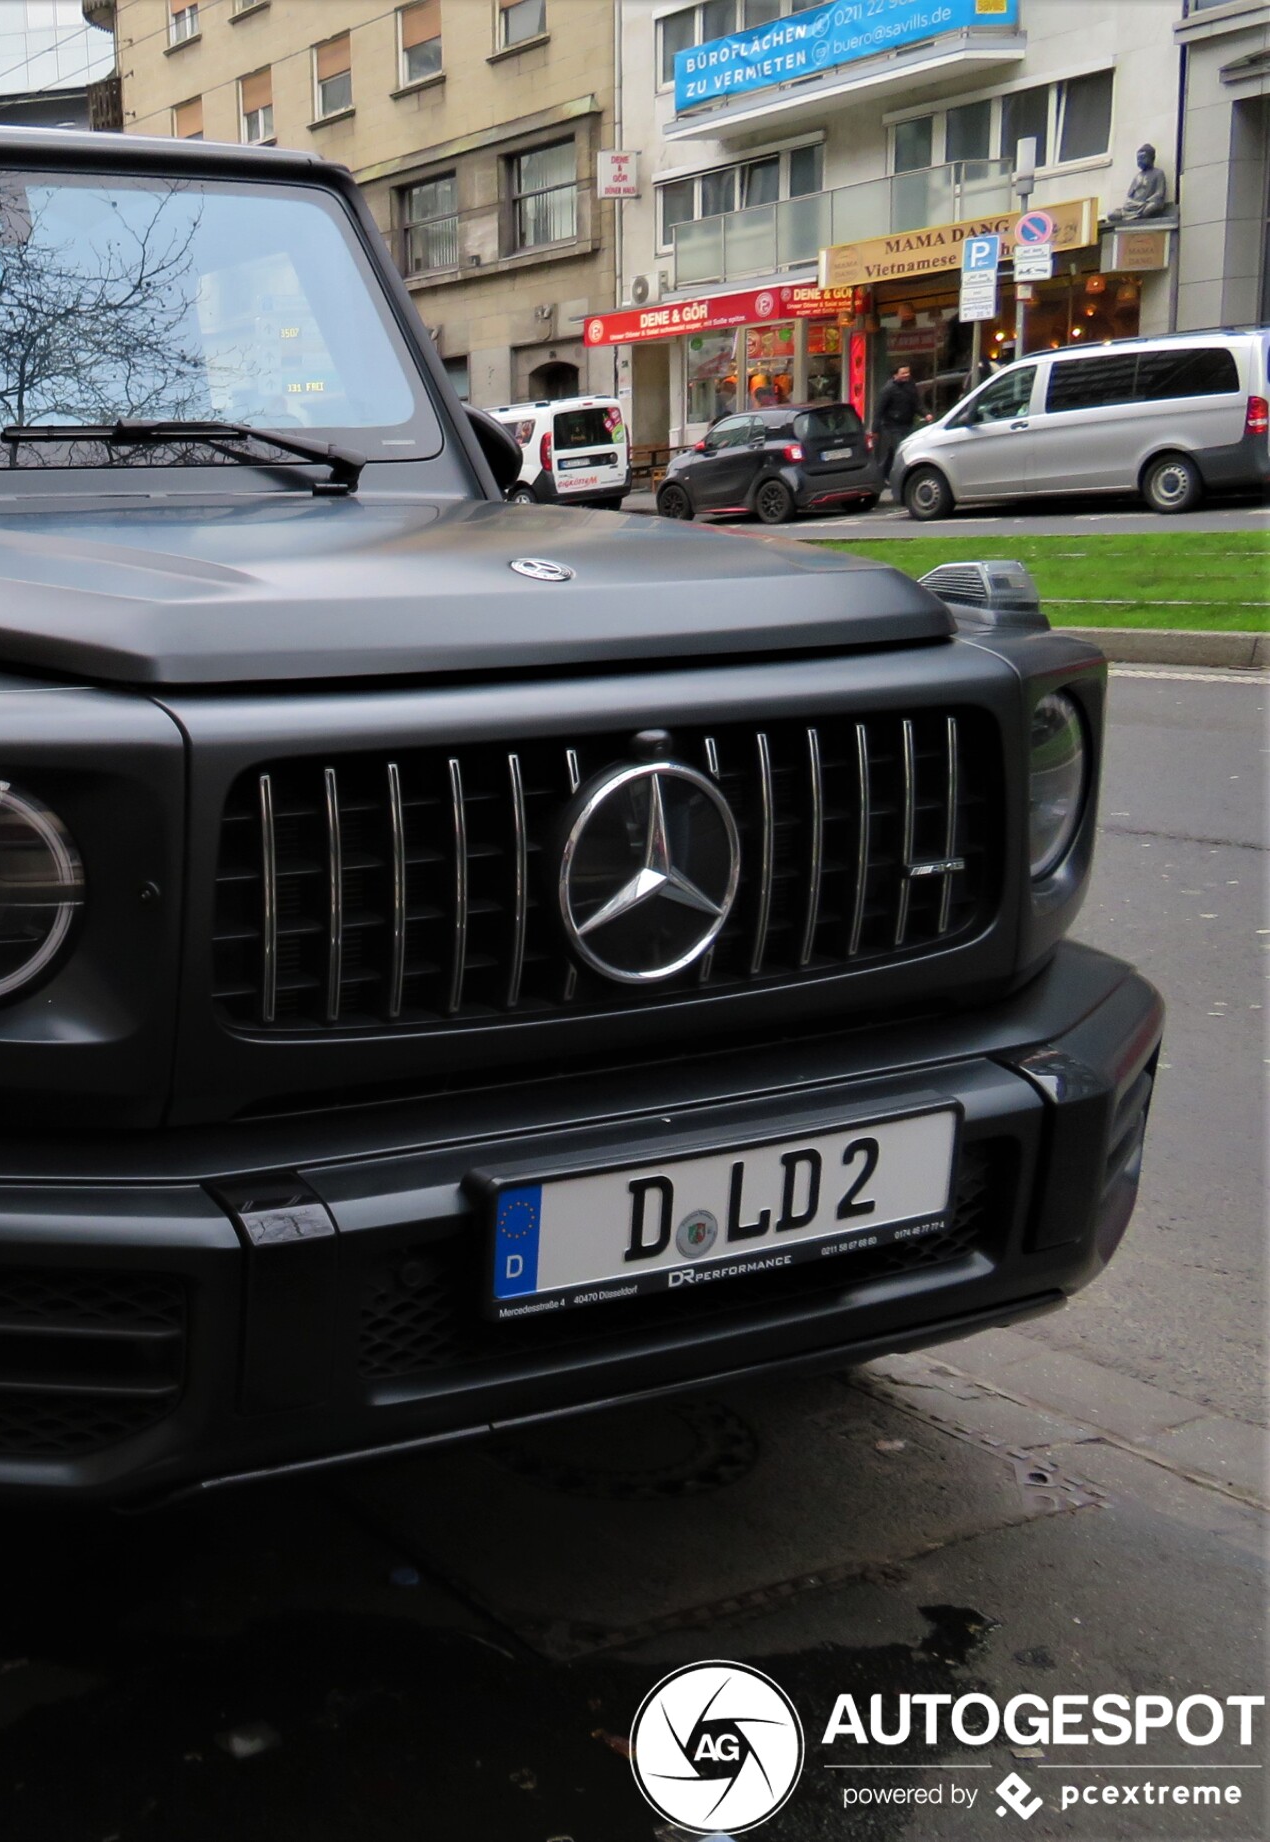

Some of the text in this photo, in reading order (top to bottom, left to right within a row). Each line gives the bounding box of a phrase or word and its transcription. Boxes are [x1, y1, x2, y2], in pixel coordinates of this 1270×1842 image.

[833, 7, 952, 54] buero@savills.de
[834, 8, 862, 27] 0211
[686, 23, 807, 73] BÜROFLÄCHEN
[686, 50, 806, 98] ZU VERMIETEN
[611, 156, 629, 164] DENE
[884, 218, 1010, 256] MAMA DANG
[864, 252, 957, 278] Vietnamese
[793, 287, 822, 301] DENE
[640, 301, 708, 329] DENE & GÖR
[624, 1174, 674, 1262] D
[506, 1254, 524, 1279] D
[574, 1285, 638, 1304] 40470 Düsseldorf
[499, 1298, 565, 1318] Mercedesstraße 4
